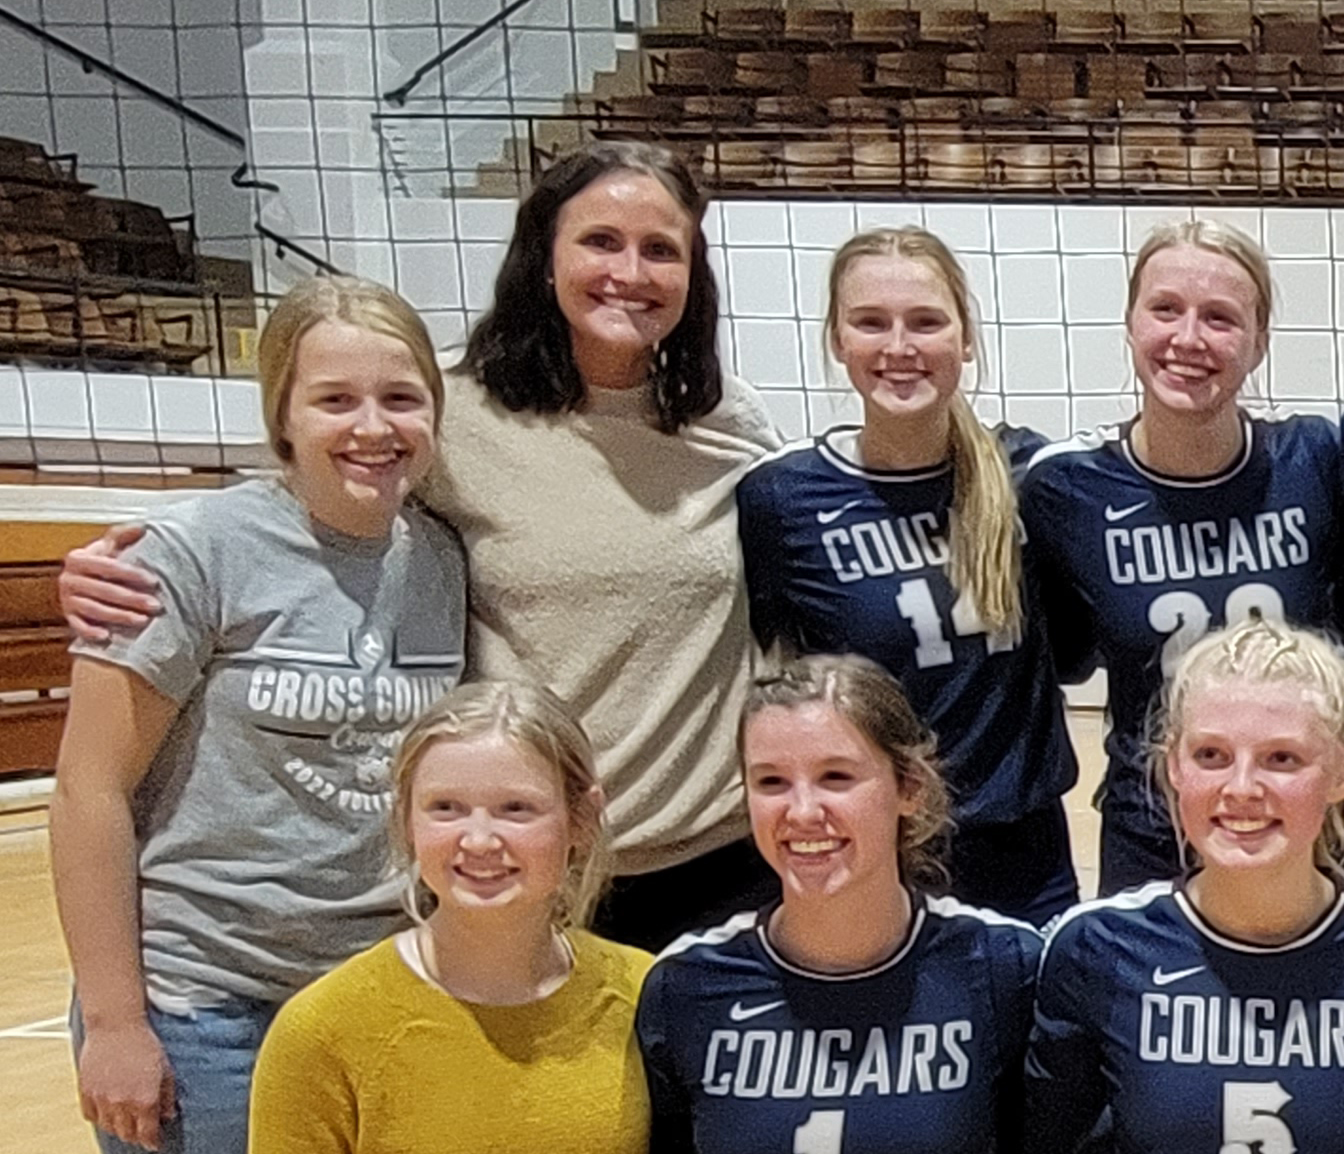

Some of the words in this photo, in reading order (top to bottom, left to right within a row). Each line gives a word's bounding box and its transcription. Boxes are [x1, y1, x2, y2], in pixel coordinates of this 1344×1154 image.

[821, 507, 1028, 582] COUG
[1105, 507, 1309, 584] COUGARS
[248, 664, 366, 723] CROSS
[374, 675, 457, 723] COUN
[284, 757, 337, 801] 2022
[703, 1020, 973, 1098] COUGARS
